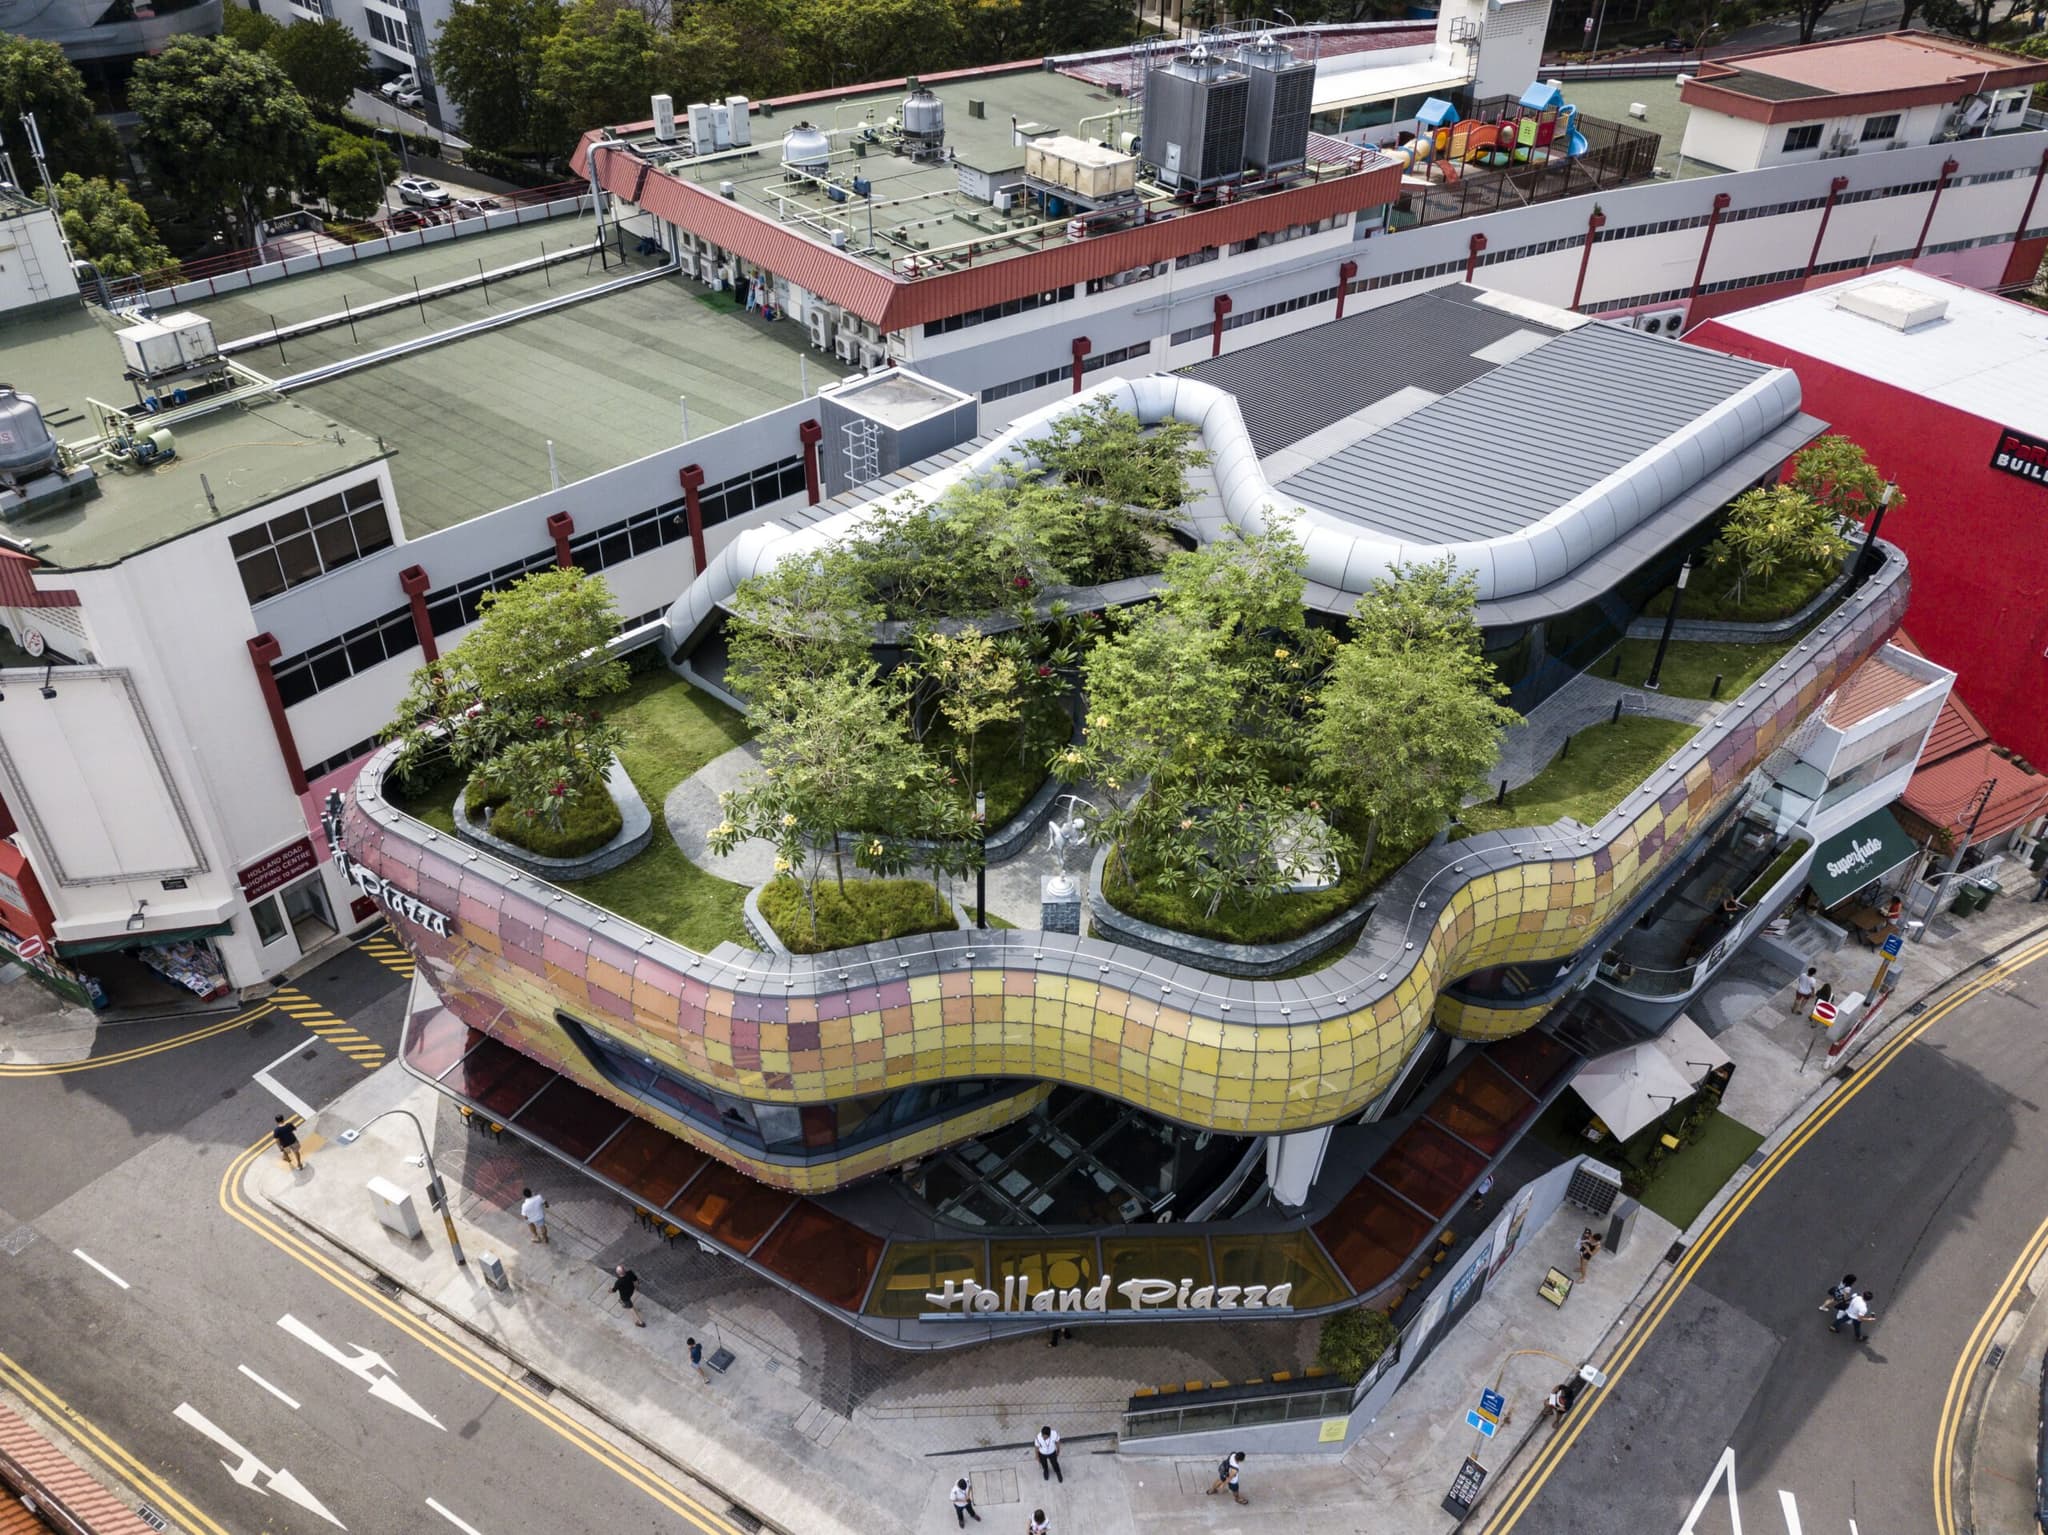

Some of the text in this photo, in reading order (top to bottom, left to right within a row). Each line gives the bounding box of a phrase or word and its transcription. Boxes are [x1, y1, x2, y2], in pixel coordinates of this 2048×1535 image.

[245, 850, 311, 888] SHOPPING CENTRE
[247, 846, 303, 879] HOLLAND ROAD
[252, 876, 282, 894] ENTRANCE
[290, 861, 309, 874] SHOPS
[350, 863, 452, 939] Piazza
[925, 1275, 1292, 1318] Holland Piazza
